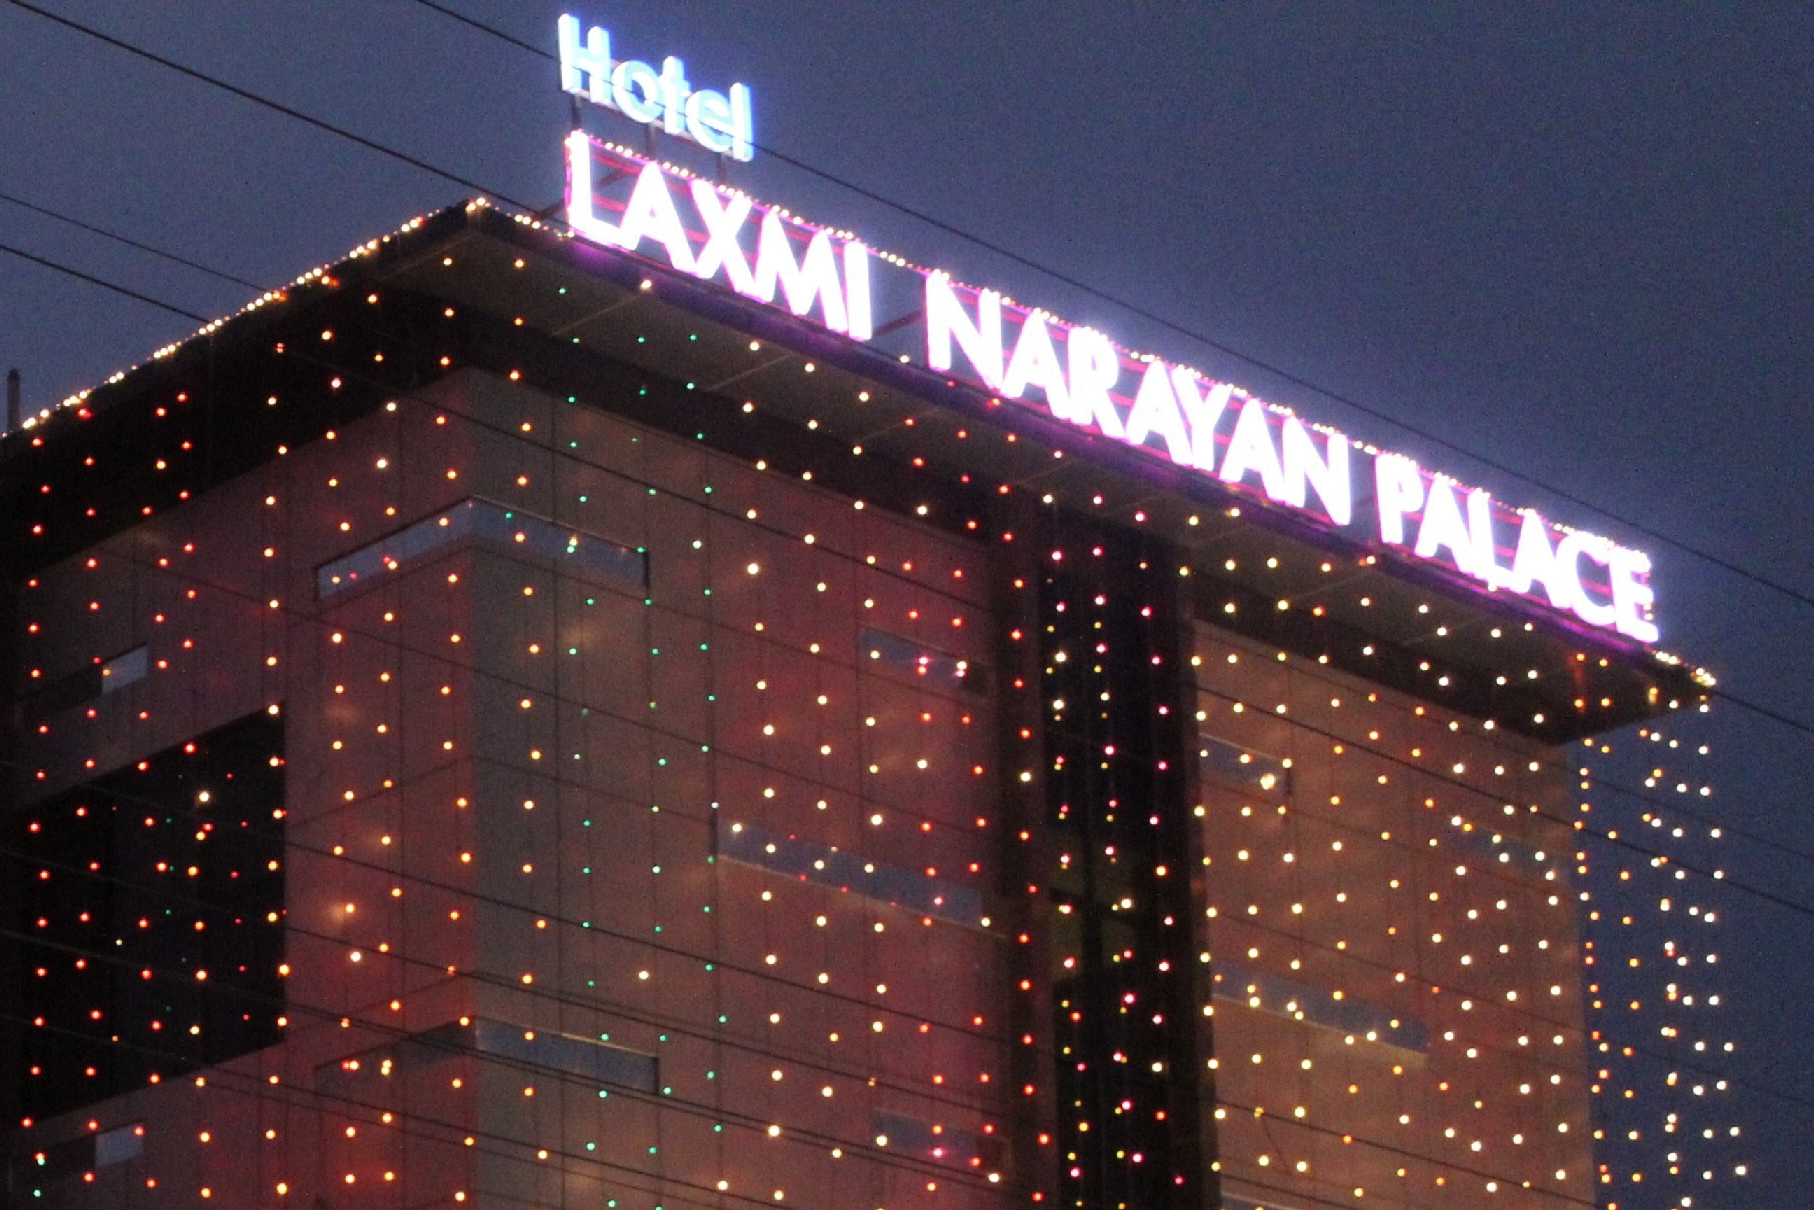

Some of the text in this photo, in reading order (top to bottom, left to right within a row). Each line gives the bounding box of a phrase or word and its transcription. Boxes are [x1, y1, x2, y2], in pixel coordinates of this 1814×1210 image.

[558, 13, 755, 162] Hotel
[567, 129, 1659, 643] LAXMI NARAYAN PALACE
